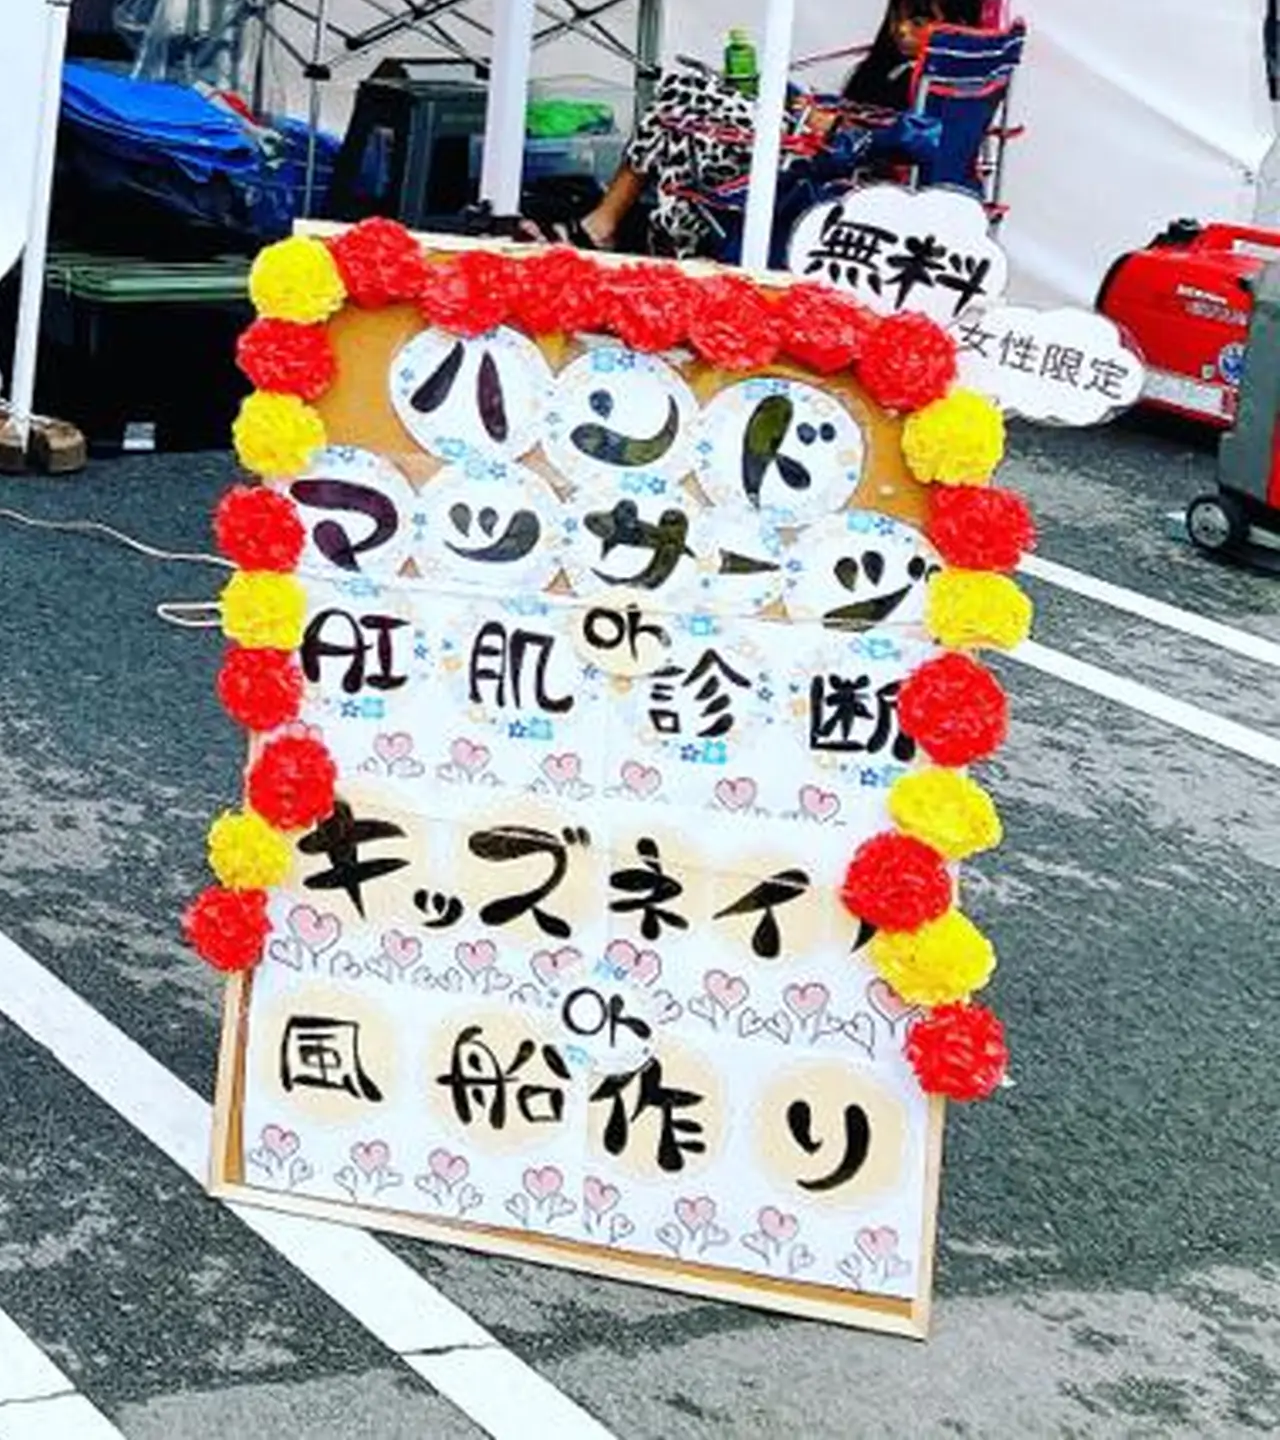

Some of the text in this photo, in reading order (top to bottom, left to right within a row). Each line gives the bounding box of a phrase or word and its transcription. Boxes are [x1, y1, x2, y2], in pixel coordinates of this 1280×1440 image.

[805, 205, 993, 319] 無料
[409, 339, 839, 511] ハンド
[957, 318, 1130, 402] 女性限定
[288, 476, 941, 631] マッサージ
[295, 800, 878, 958] キッズネイ
[280, 1014, 872, 1192] 風船作り
